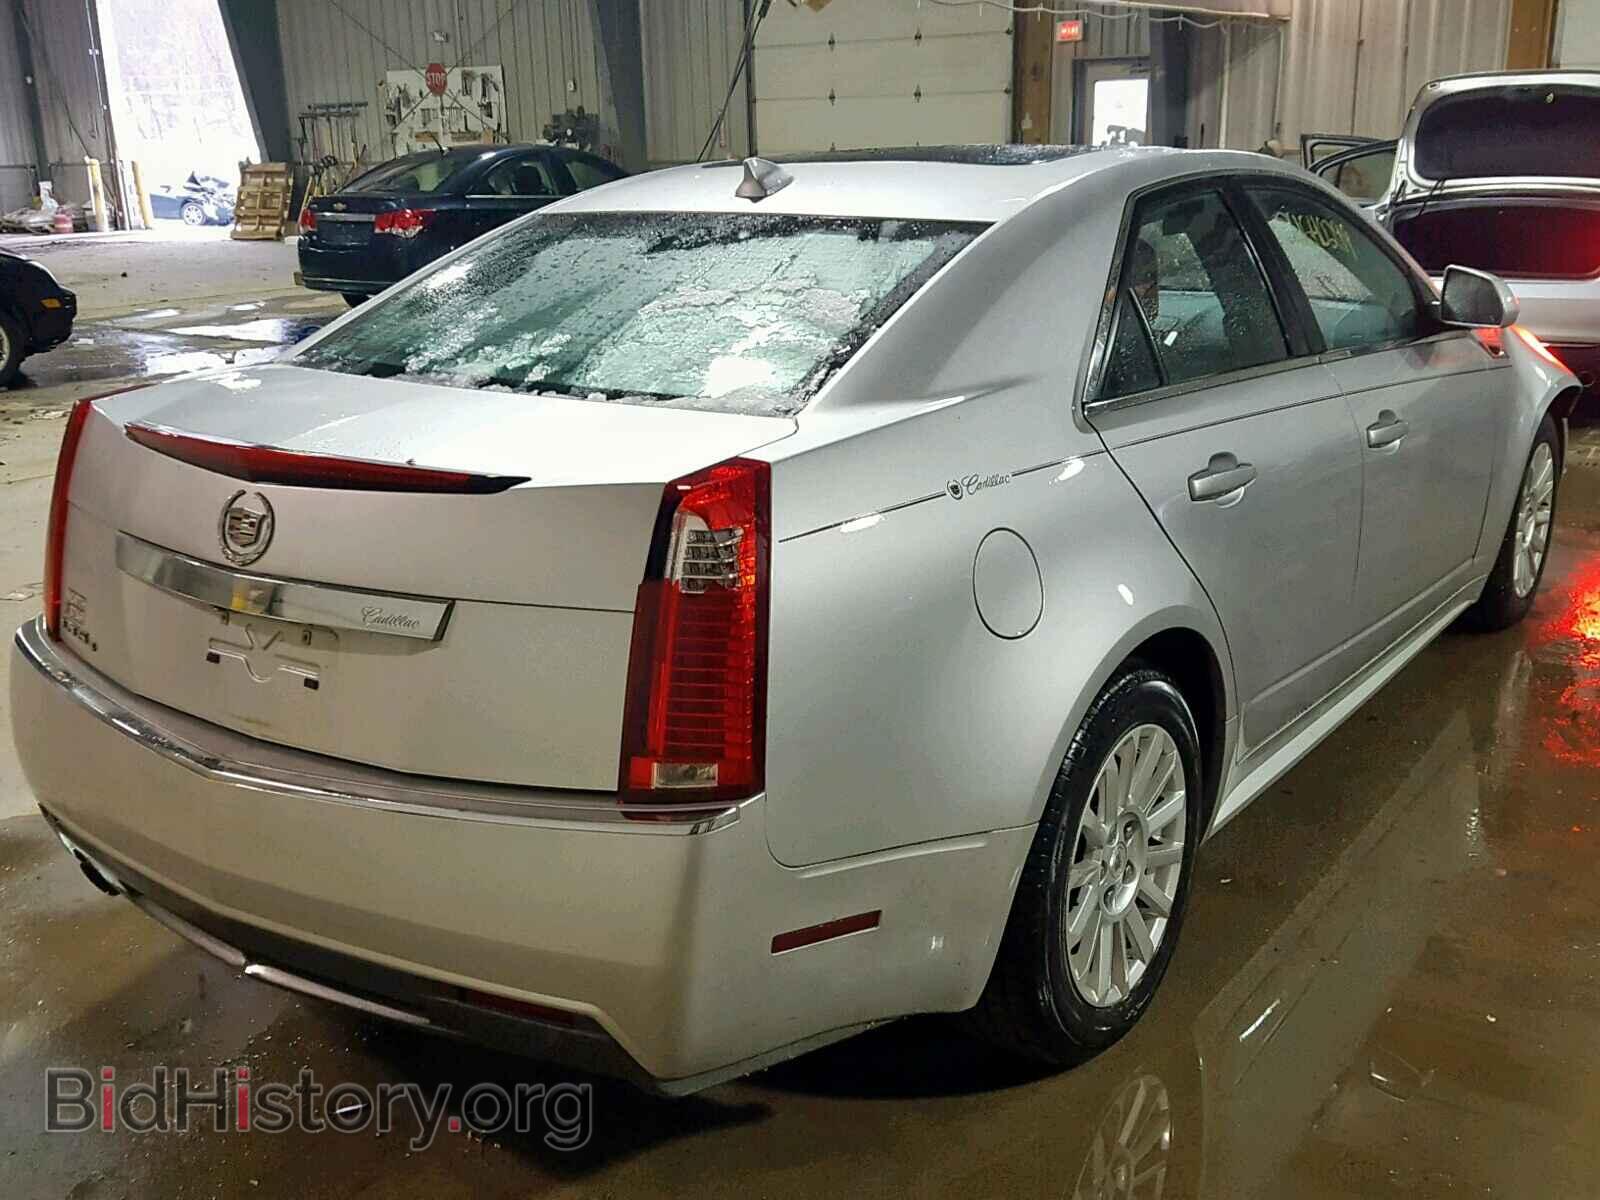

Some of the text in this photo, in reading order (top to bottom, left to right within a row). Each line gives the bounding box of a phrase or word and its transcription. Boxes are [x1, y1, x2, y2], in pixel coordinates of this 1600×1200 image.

[426, 72, 446, 88] STOP
[961, 473, 1010, 495] Cadillac
[361, 606, 420, 627] Cadillac
